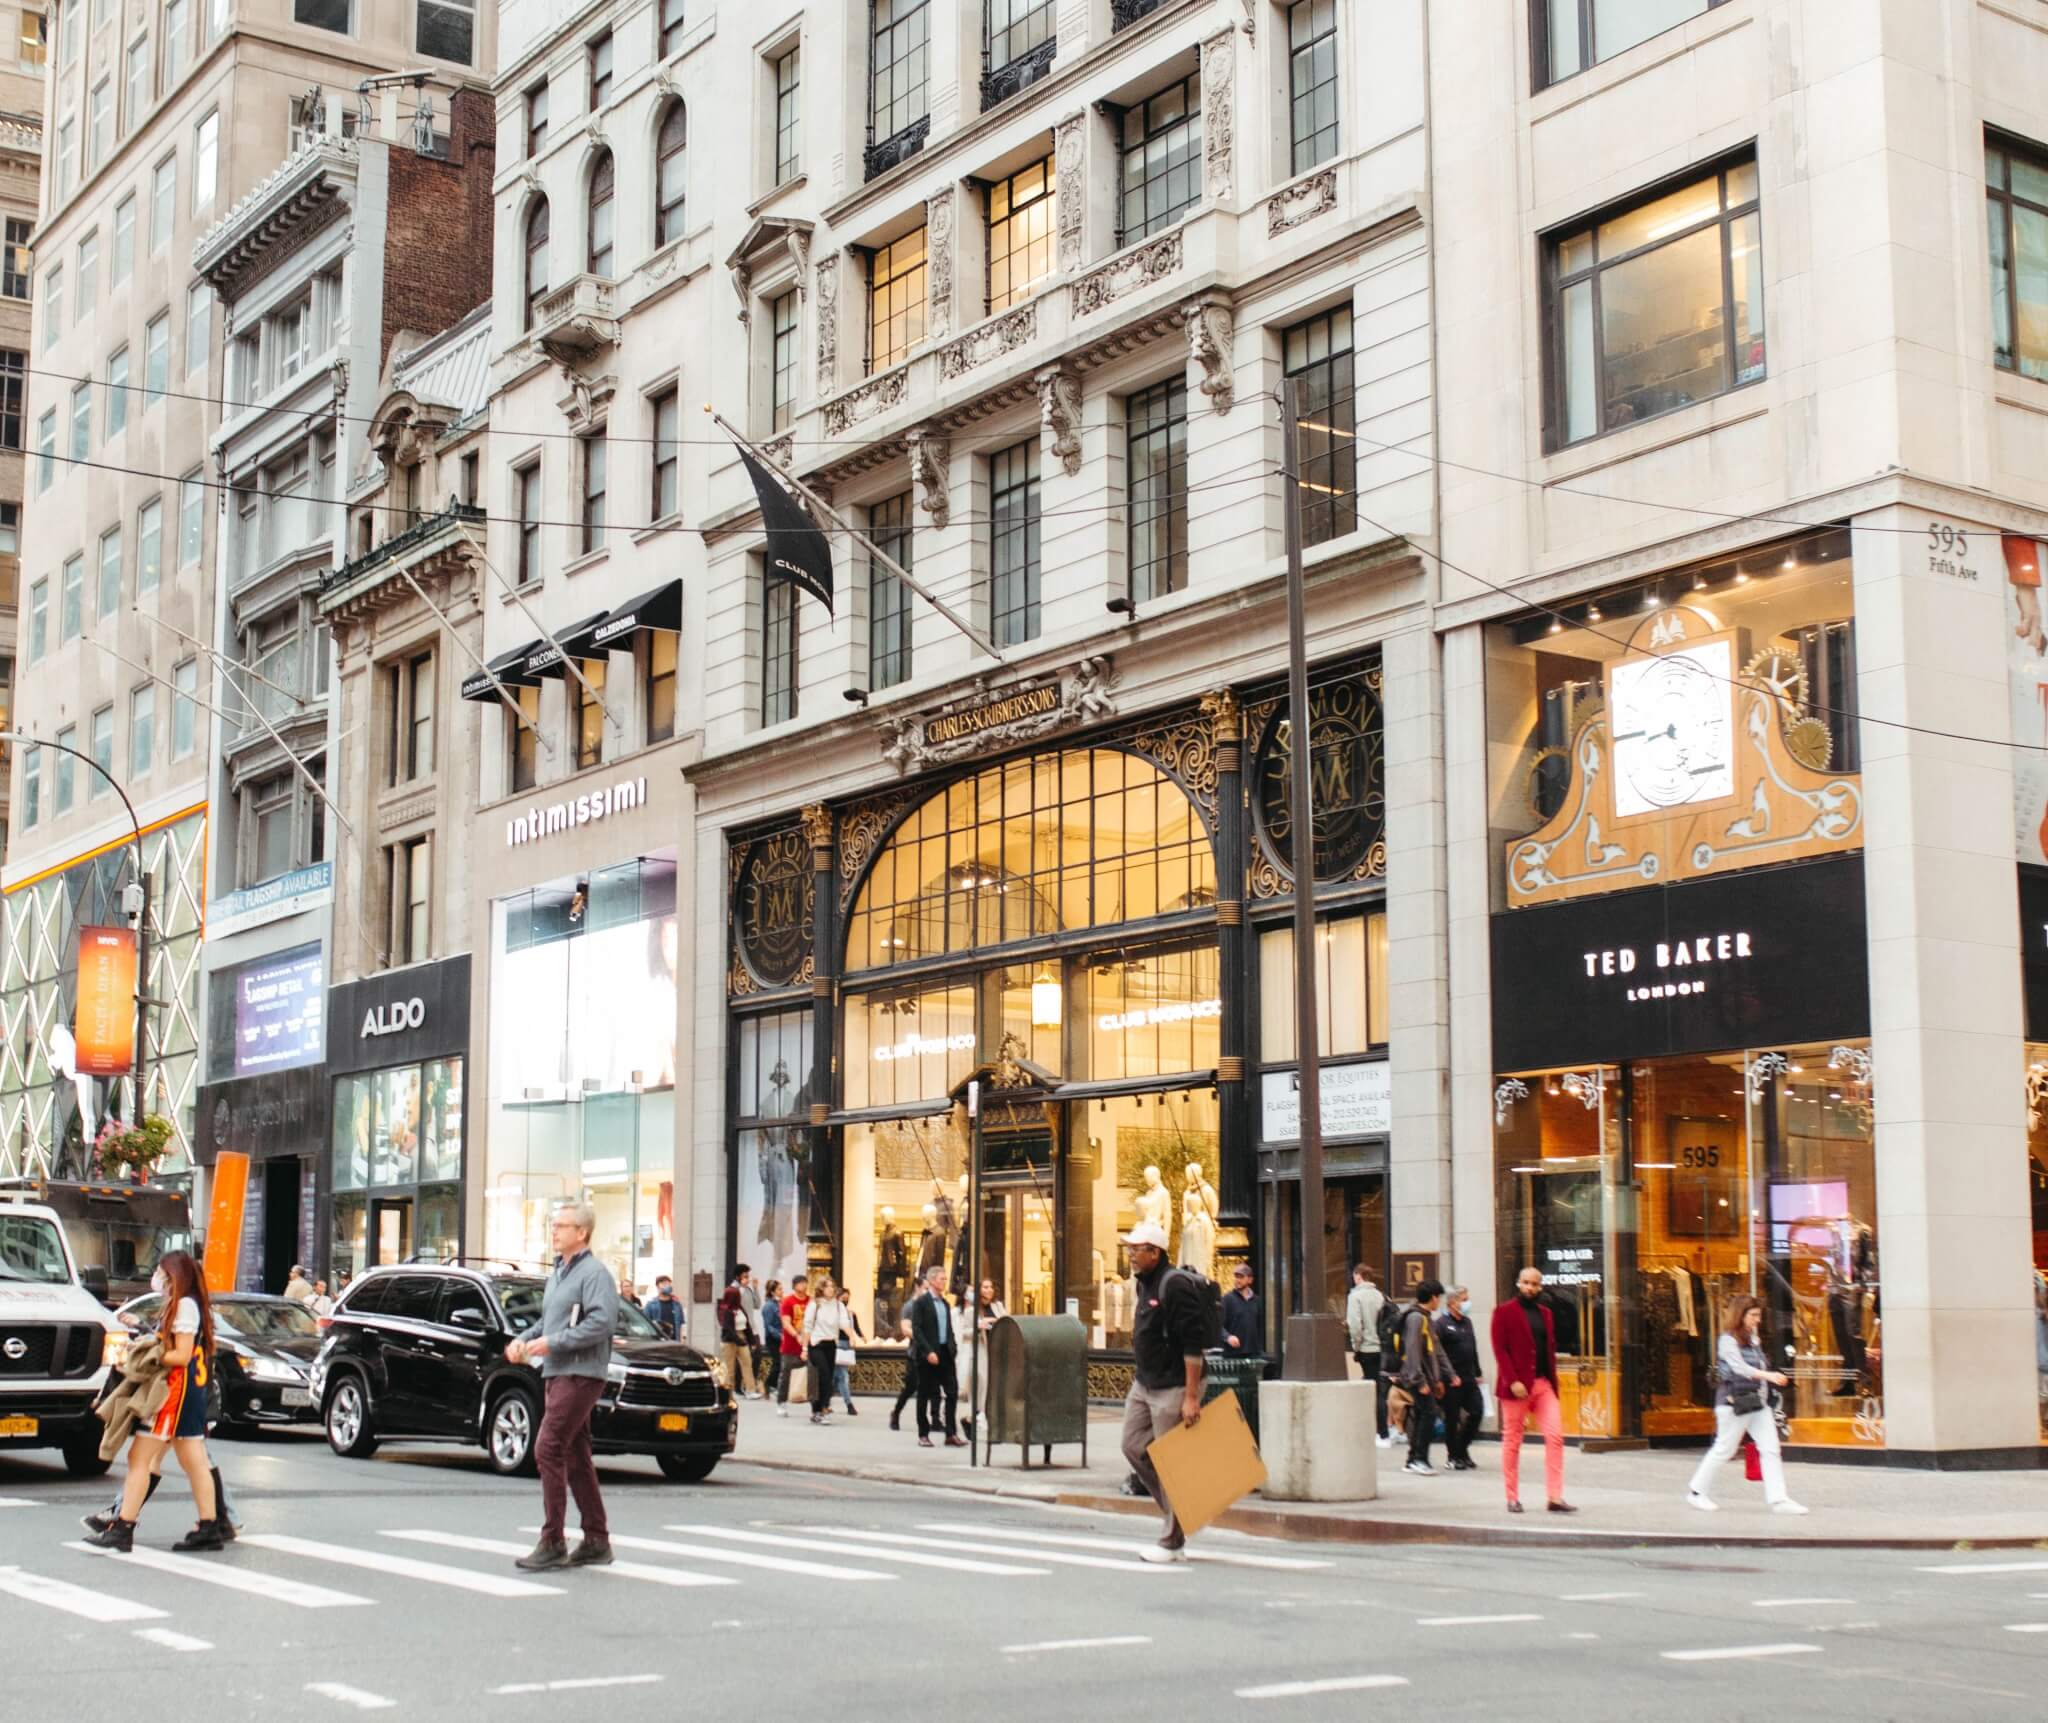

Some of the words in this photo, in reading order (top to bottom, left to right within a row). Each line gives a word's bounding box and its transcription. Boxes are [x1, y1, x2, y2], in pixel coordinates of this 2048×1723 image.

[1928, 523, 1968, 557] 595
[775, 559, 808, 579] CLUB
[1928, 556, 1956, 576] Fifth
[1958, 564, 1978, 581] Ave
[506, 776, 647, 847] intimissimi
[285, 866, 329, 895] AVAILABLE
[1583, 948, 1636, 977] TED
[1655, 932, 1752, 968] BAKER
[1626, 980, 1705, 1002] LONDON
[360, 996, 426, 1039] ALDO
[1098, 1010, 1146, 1031] CLUB
[1683, 1145, 1719, 1169] 595
